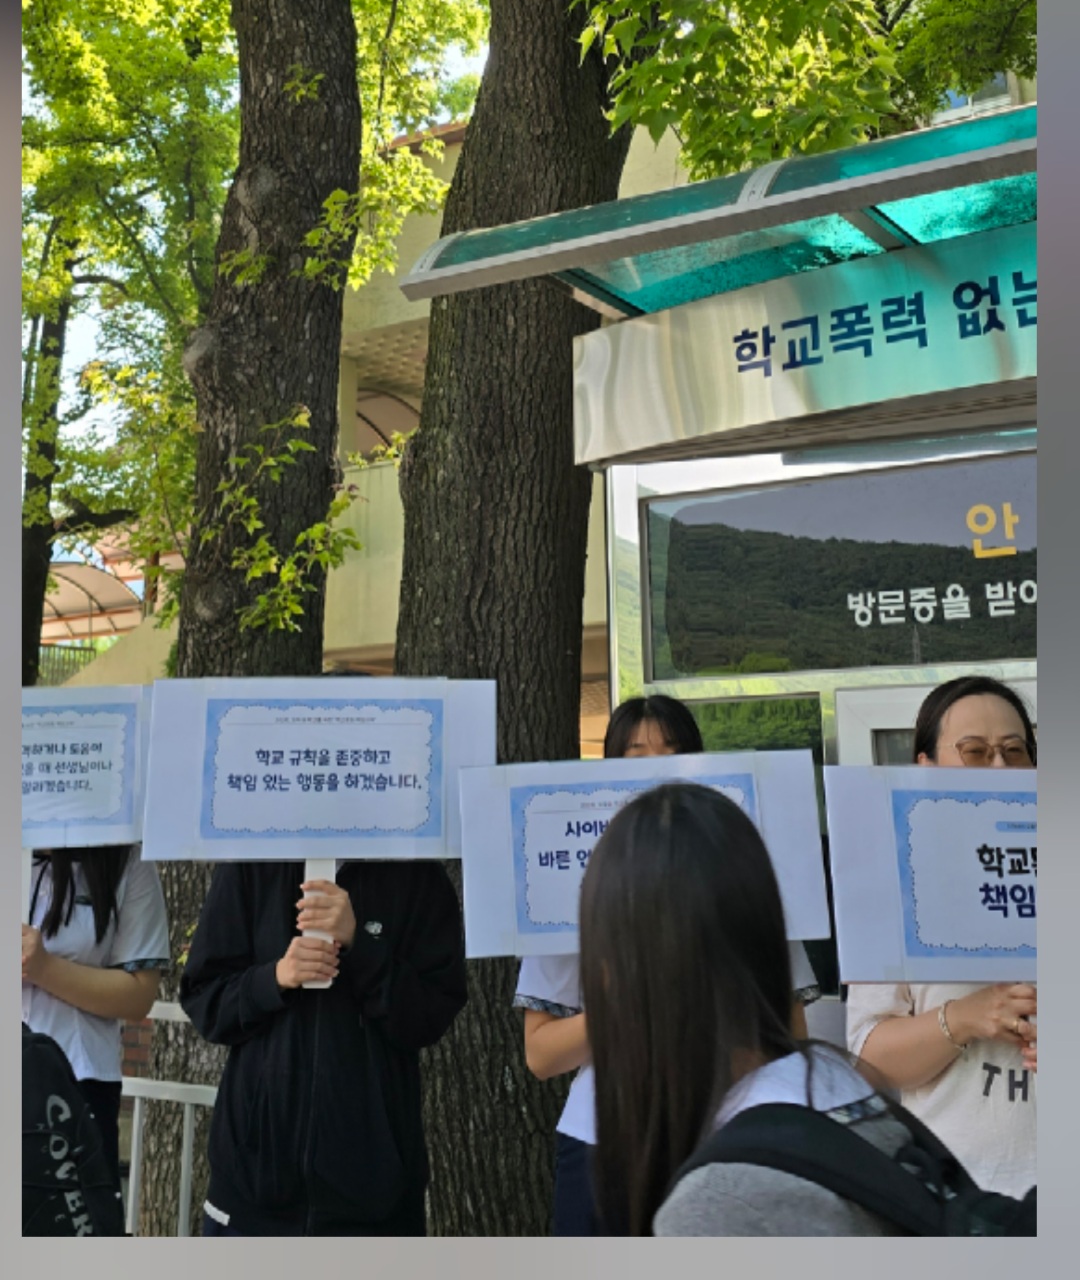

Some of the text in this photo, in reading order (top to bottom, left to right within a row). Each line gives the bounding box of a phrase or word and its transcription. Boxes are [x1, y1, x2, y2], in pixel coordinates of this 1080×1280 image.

[733, 290, 929, 378] 학교폭력
[966, 501, 1020, 559] 안
[847, 583, 971, 628] 방문증을
[69, 742, 103, 755] 도움이
[256, 748, 391, 766] 학교 규칙을 존중하고
[38, 761, 51, 774] 때
[55, 760, 113, 774] 선생님이나
[227, 772, 422, 792] 책임 있는 행동을 하겠습니다.
[538, 849, 571, 871] 바른
[979, 882, 1037, 919] 책임
